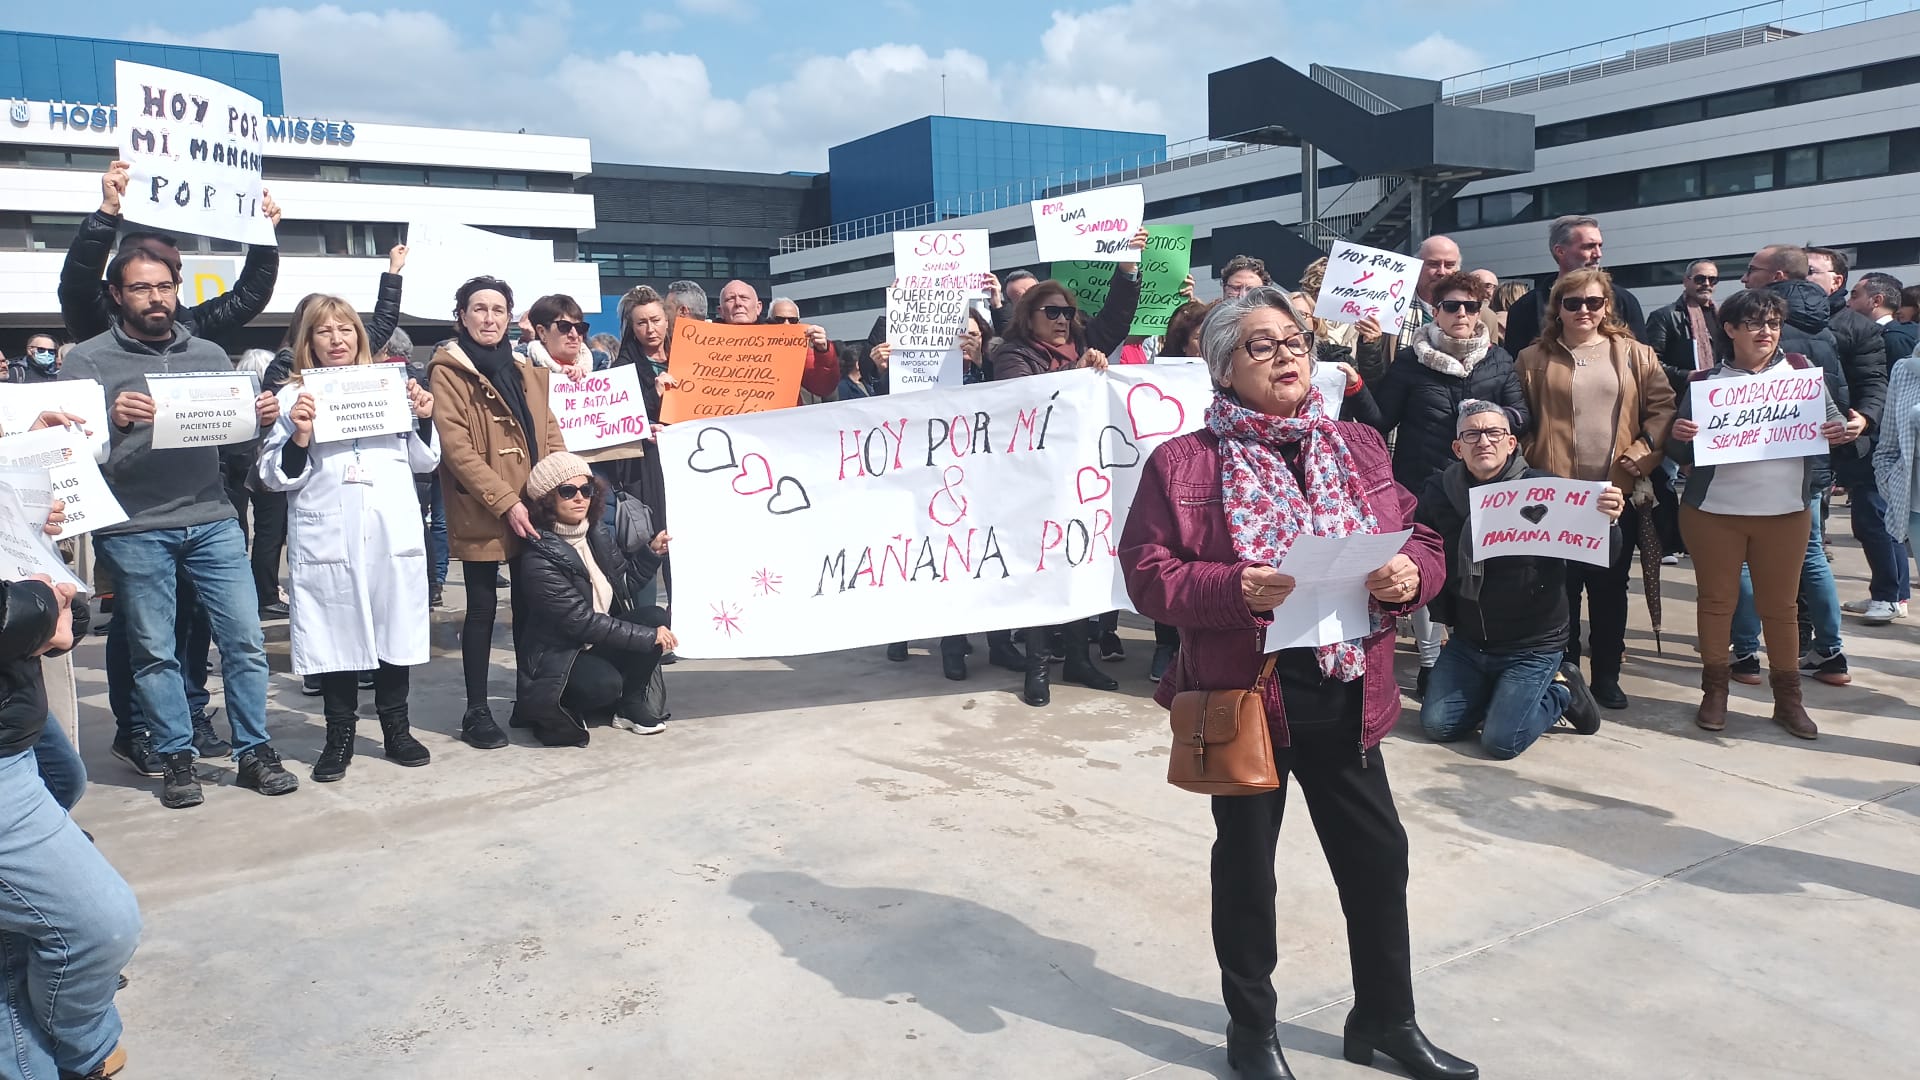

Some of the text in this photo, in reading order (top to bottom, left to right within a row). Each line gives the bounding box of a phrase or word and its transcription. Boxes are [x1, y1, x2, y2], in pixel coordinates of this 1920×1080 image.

[141, 85, 259, 141] HOY POR
[266, 119, 355, 144] MISSES
[149, 176, 256, 217] POR TI
[1042, 202, 1064, 216] POR
[1061, 208, 1086, 222] UNA
[1074, 218, 1129, 235] SANIDAD
[914, 233, 965, 256] SOS
[1094, 238, 1130, 254] DIGNA
[1338, 248, 1368, 264] HOY
[1368, 254, 1391, 268] POR
[1353, 270, 1374, 285] Y
[892, 288, 965, 304] QUEREMOS
[906, 302, 961, 314] MEDICOS
[1341, 301, 1360, 316] POR
[890, 310, 965, 324] QUE NOS CUREN
[890, 323, 908, 334] NO
[909, 323, 928, 335] QUE
[900, 335, 954, 347] CATALAN
[902, 351, 940, 359] NO A LA
[901, 376, 940, 384] CATALAN
[1708, 376, 1823, 407] COMPAÑEROS
[341, 402, 367, 410] APOYO
[565, 390, 629, 411] DE BATALLA
[175, 411, 186, 420] EN
[187, 410, 214, 419] APOYO
[223, 409, 237, 417] LOS
[336, 412, 374, 422] PACIENTES
[559, 413, 606, 429] SIEMPRE
[1707, 403, 1801, 430] DE BATALLA
[180, 422, 221, 430] PACIENTES
[358, 423, 385, 432] MISSES
[595, 415, 645, 438] JUNTOS
[183, 434, 228, 443] CAN MISSES
[1707, 421, 1817, 450] SIEMPRE JUNTOS
[838, 417, 909, 481] HOY
[925, 411, 992, 467] POR
[60, 477, 79, 489] LOS
[66, 493, 81, 504] DE
[927, 465, 968, 527] &
[1480, 490, 1519, 510] HOY
[1525, 487, 1556, 501] POR
[1481, 528, 1551, 547] MAÑANA
[1557, 530, 1584, 547] POR
[811, 509, 1118, 598] MAÑANA POR
